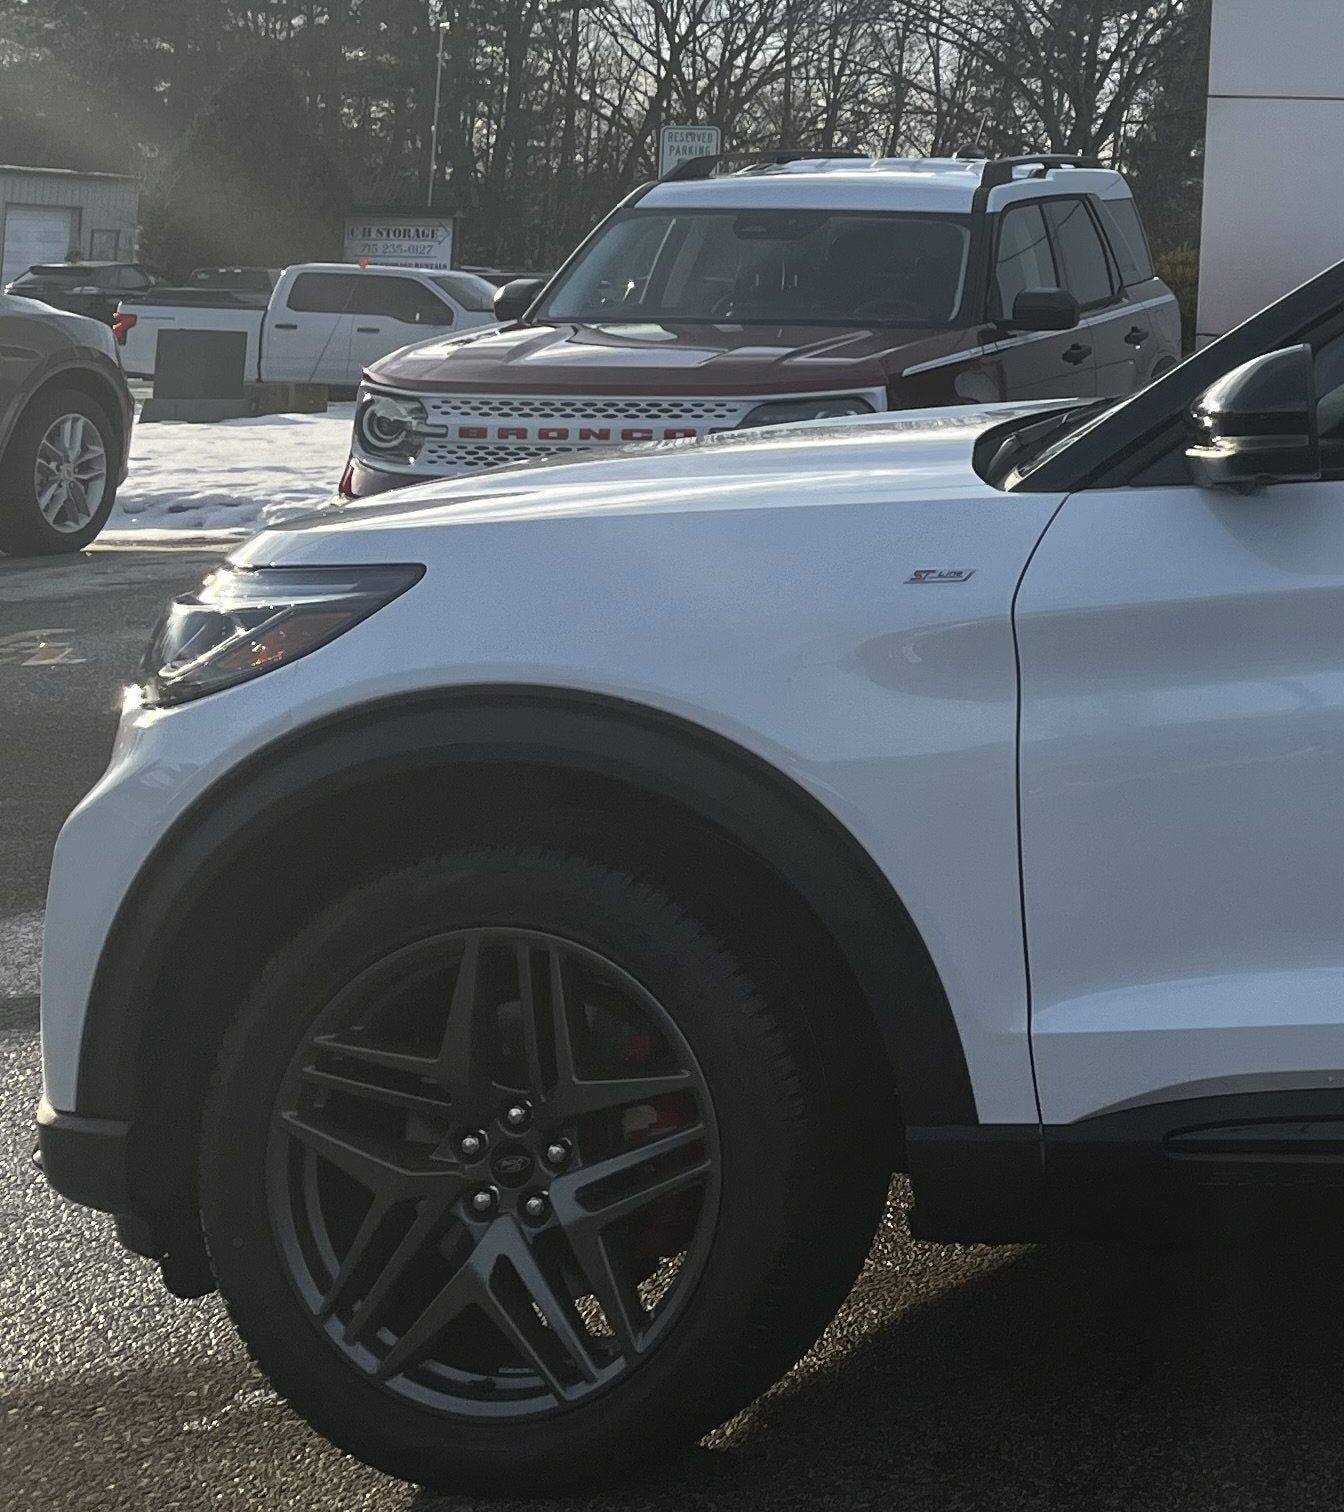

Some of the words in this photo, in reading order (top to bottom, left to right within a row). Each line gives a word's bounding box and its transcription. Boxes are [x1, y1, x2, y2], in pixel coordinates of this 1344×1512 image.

[668, 132, 713, 143] RESERVED
[669, 145, 711, 156] PARKING
[376, 227, 439, 239] STORAGE
[360, 243, 378, 254] 715
[458, 426, 697, 441] BRONCO
